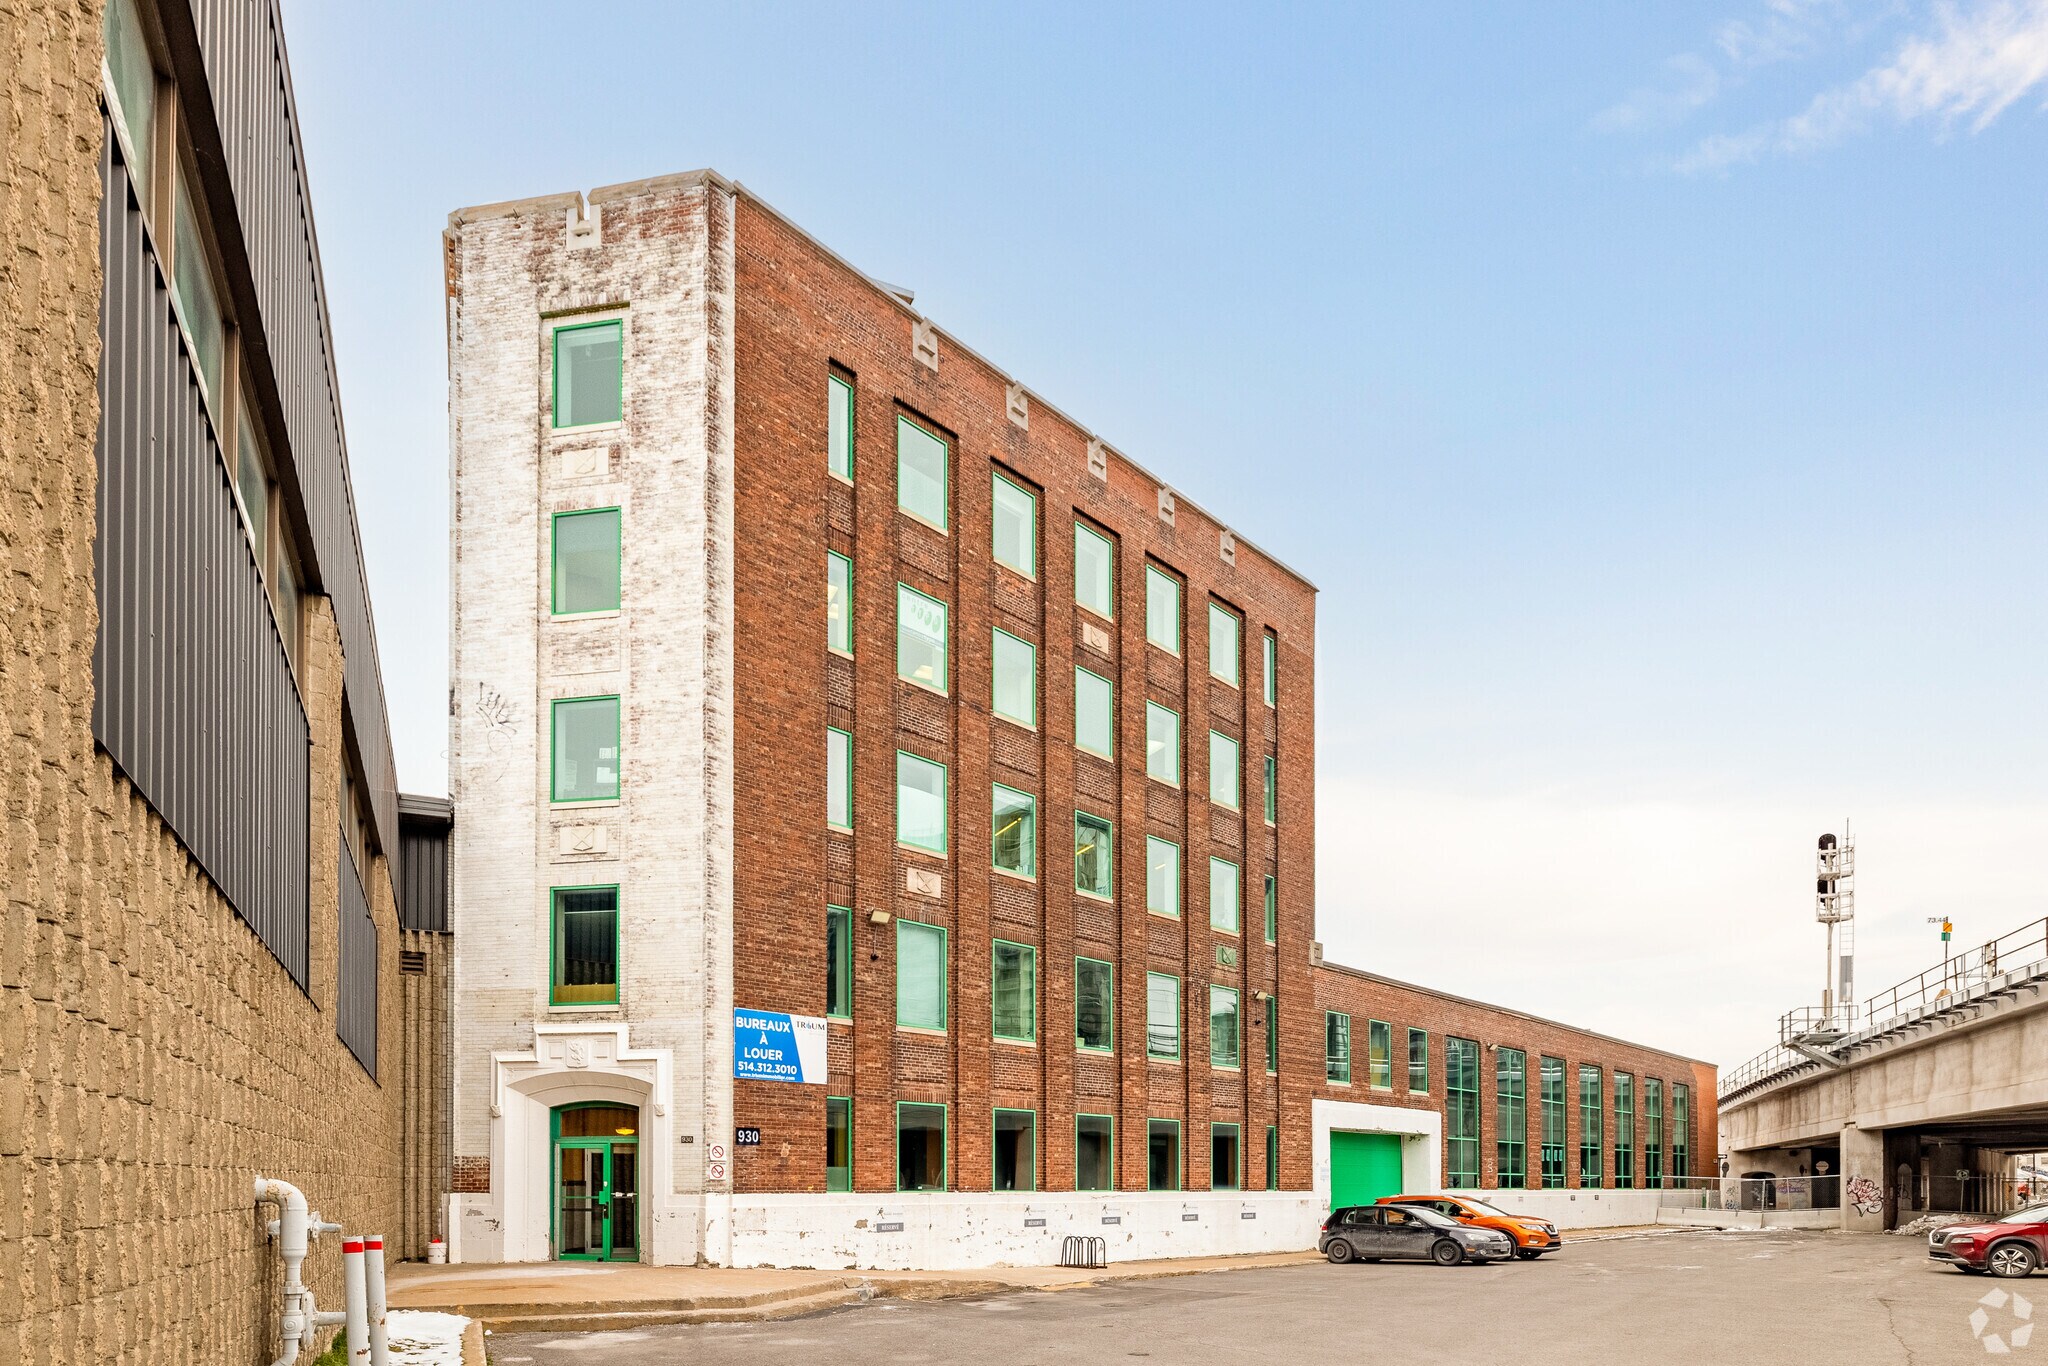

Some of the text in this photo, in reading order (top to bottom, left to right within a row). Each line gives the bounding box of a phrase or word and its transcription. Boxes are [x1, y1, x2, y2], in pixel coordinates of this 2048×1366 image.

[735, 1016, 791, 1033] BUREAUX
[759, 1031, 768, 1045] À
[744, 1047, 783, 1061] LOUER
[738, 1061, 797, 1075] 514.312.3010
[738, 1129, 759, 1143] 930
